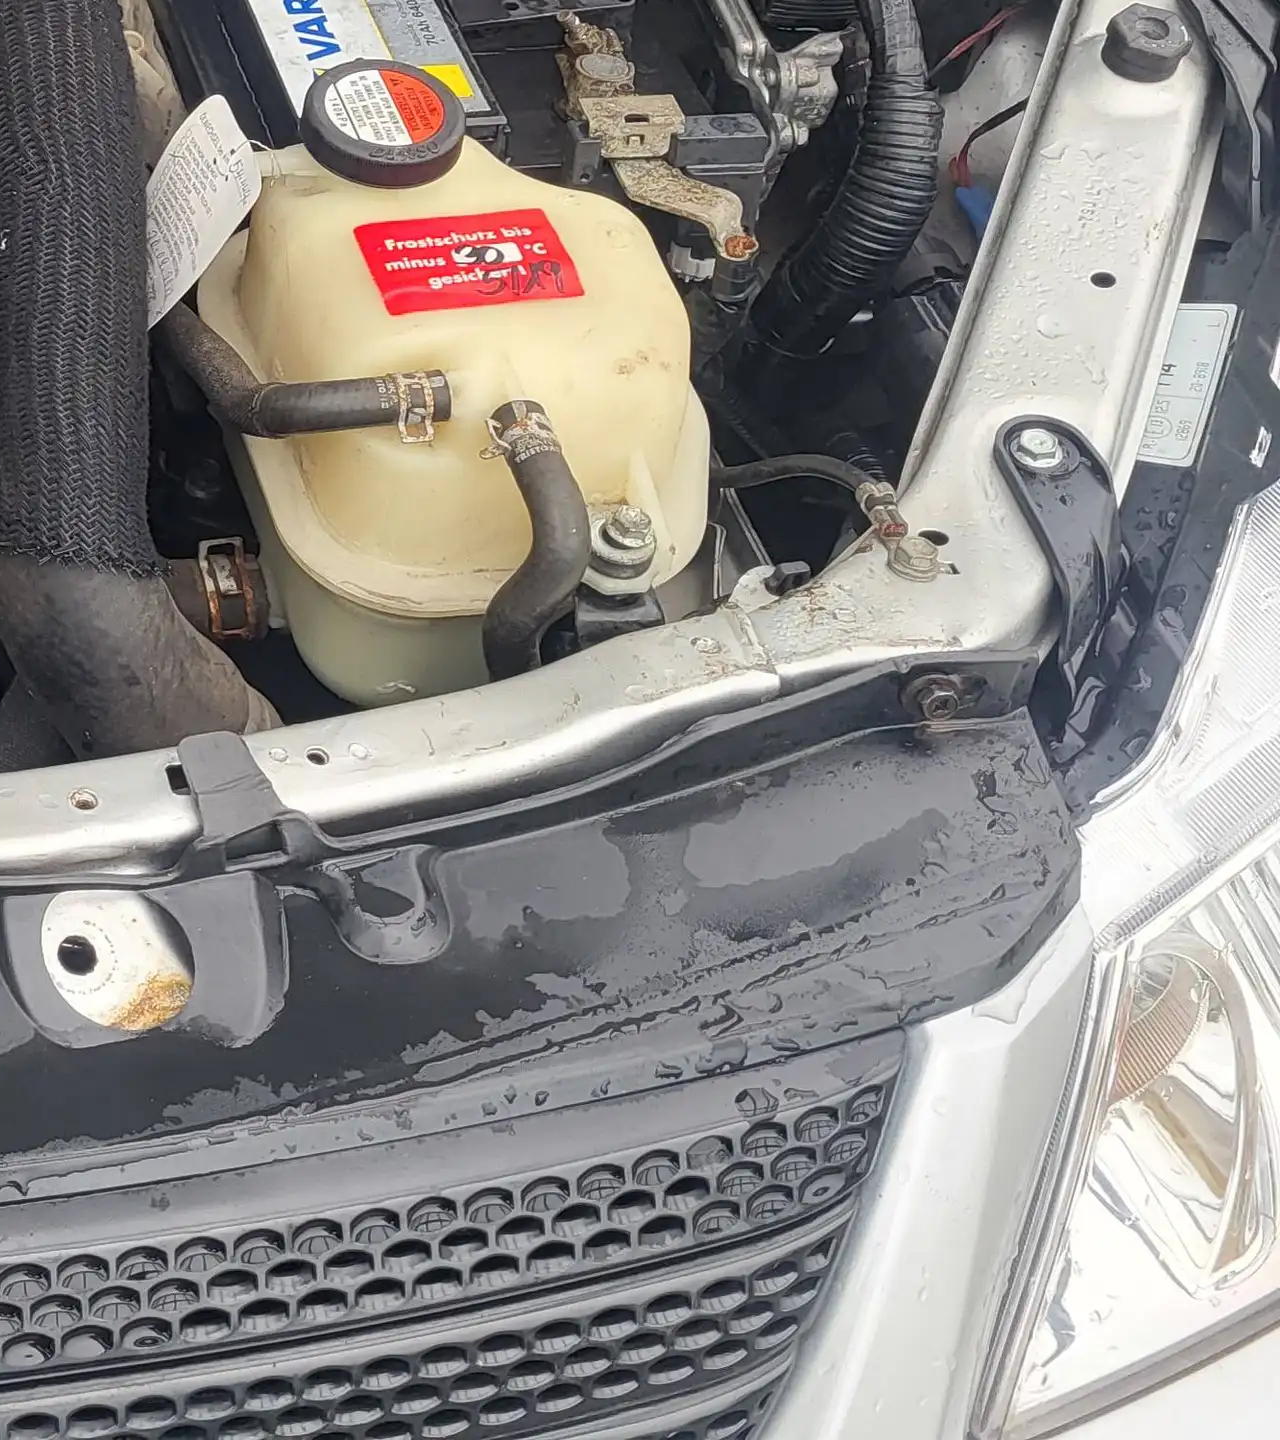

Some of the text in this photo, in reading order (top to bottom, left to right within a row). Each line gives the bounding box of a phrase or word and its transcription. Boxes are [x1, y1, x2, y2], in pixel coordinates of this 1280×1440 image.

[384, 226, 532, 251] Frostschutz bis
[385, 255, 446, 271] minus
[524, 242, 547, 255] °C
